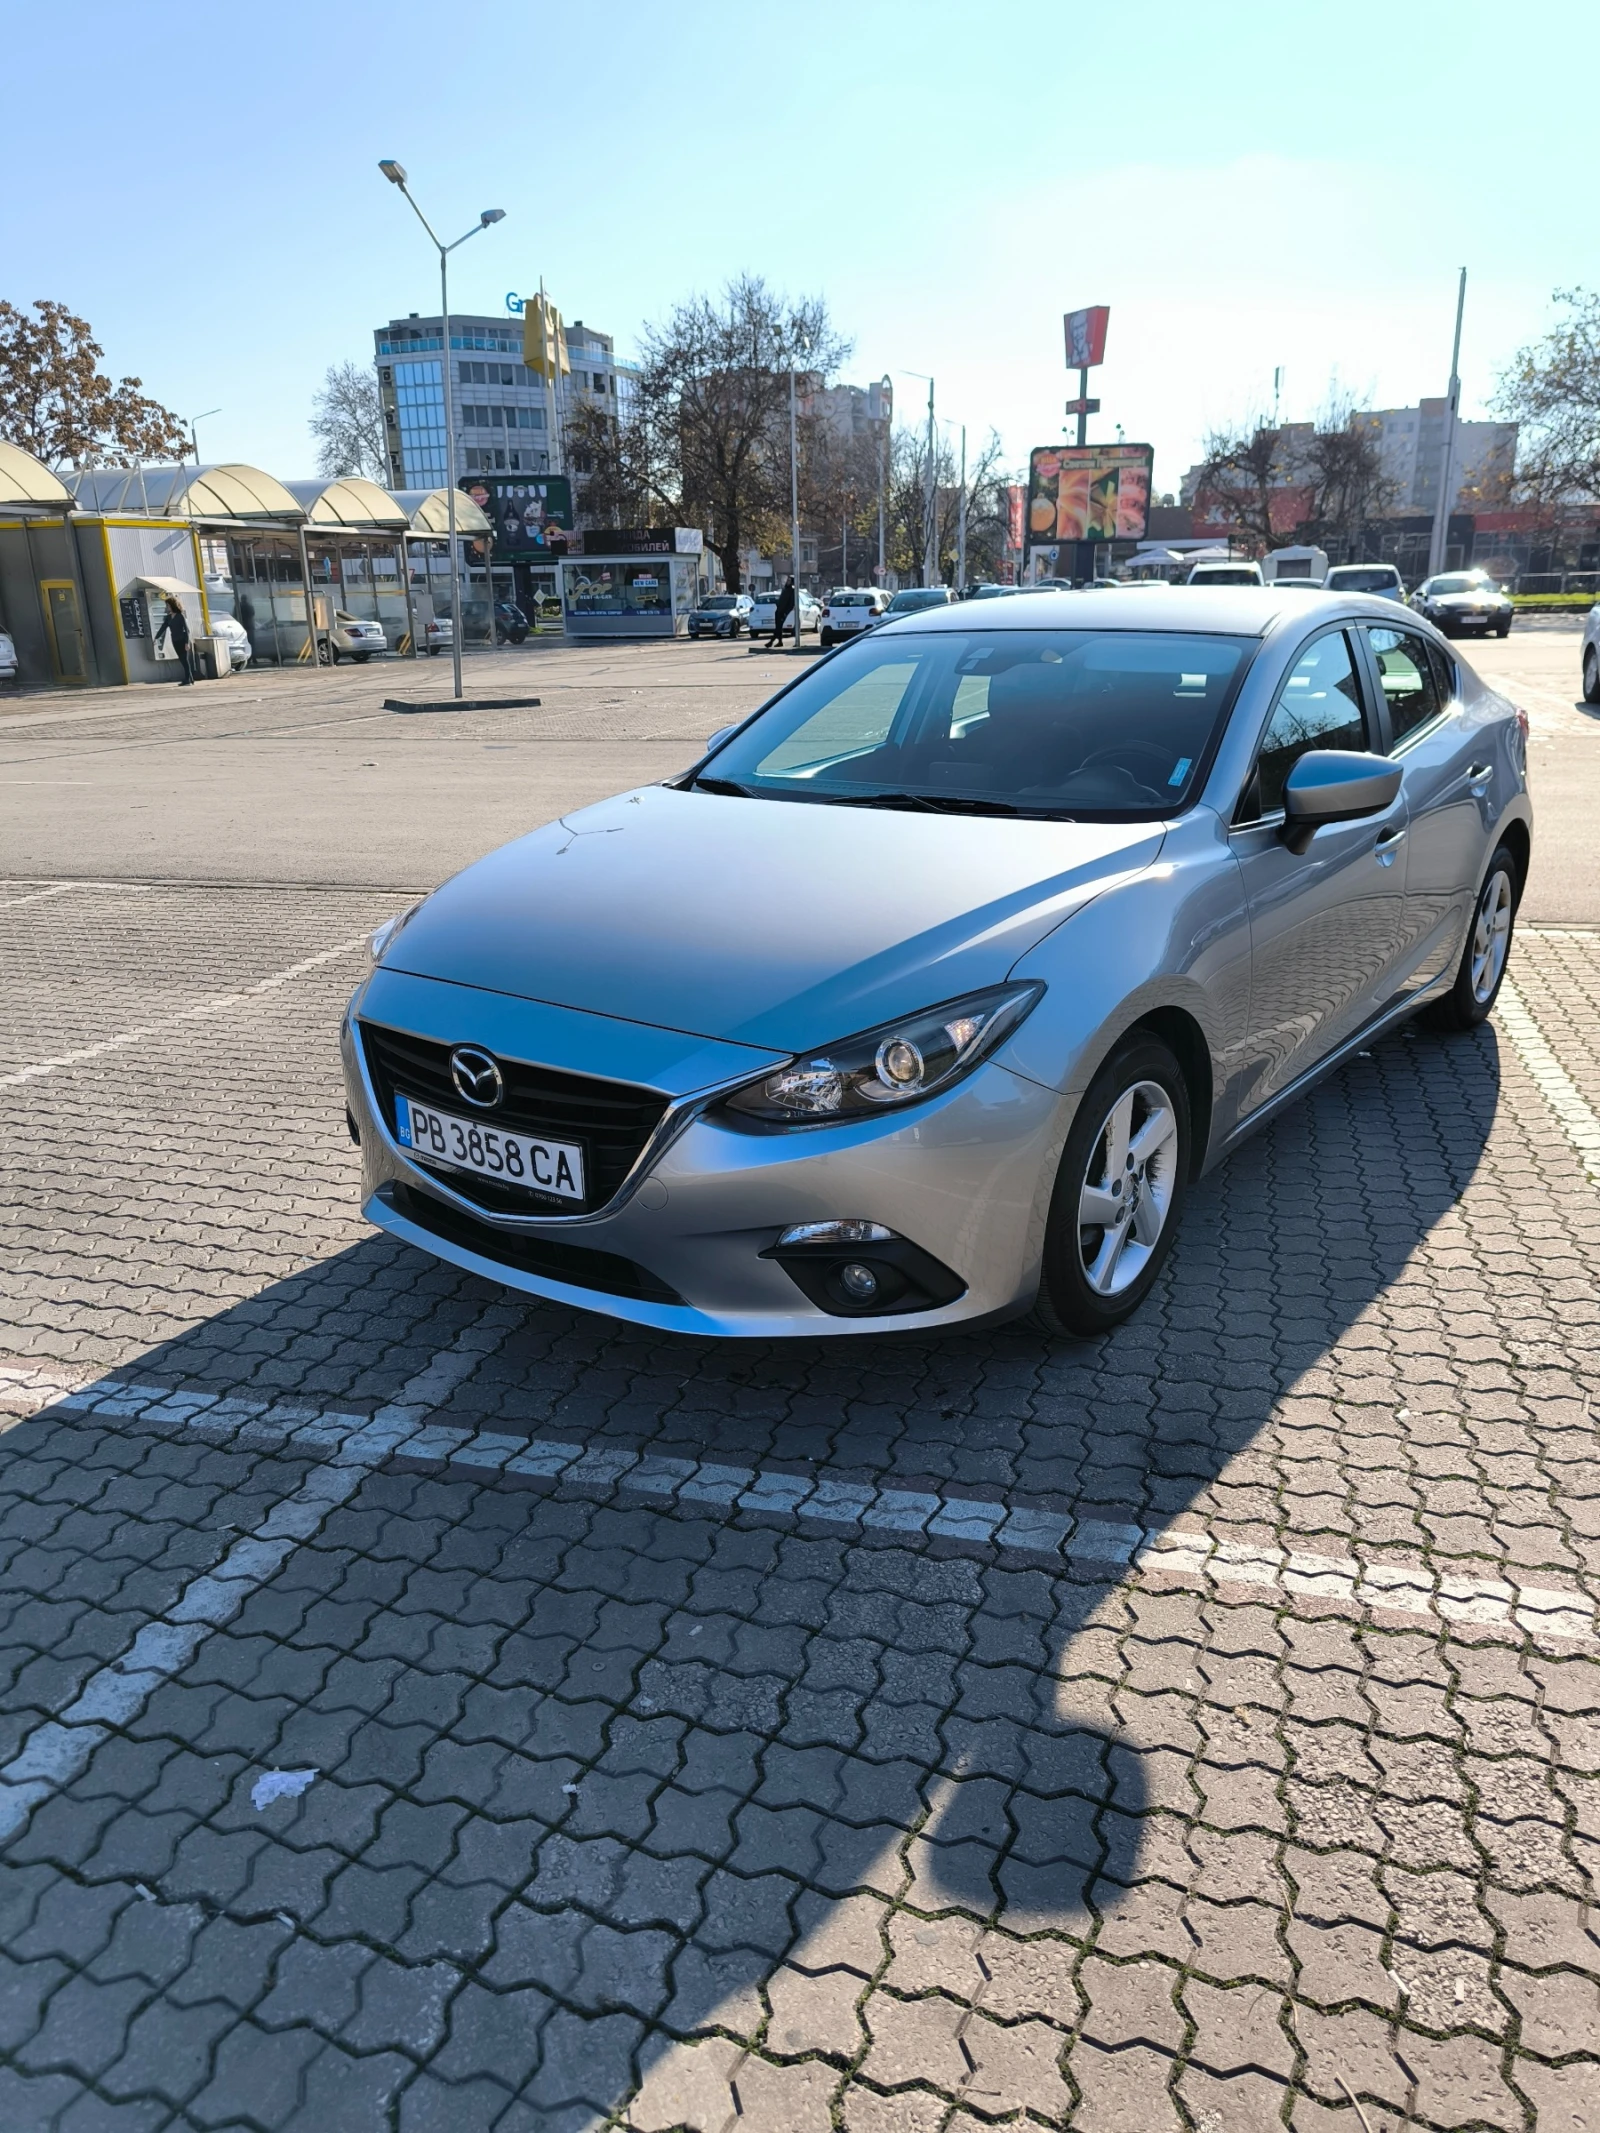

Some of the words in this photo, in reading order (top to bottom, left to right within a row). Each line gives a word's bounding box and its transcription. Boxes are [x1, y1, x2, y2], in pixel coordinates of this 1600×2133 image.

[505, 291, 525, 313] Gr
[400, 1125, 411, 1140] BG
[411, 1106, 447, 1154] PB
[450, 1124, 525, 1178] 3858
[530, 1144, 576, 1192] CA
